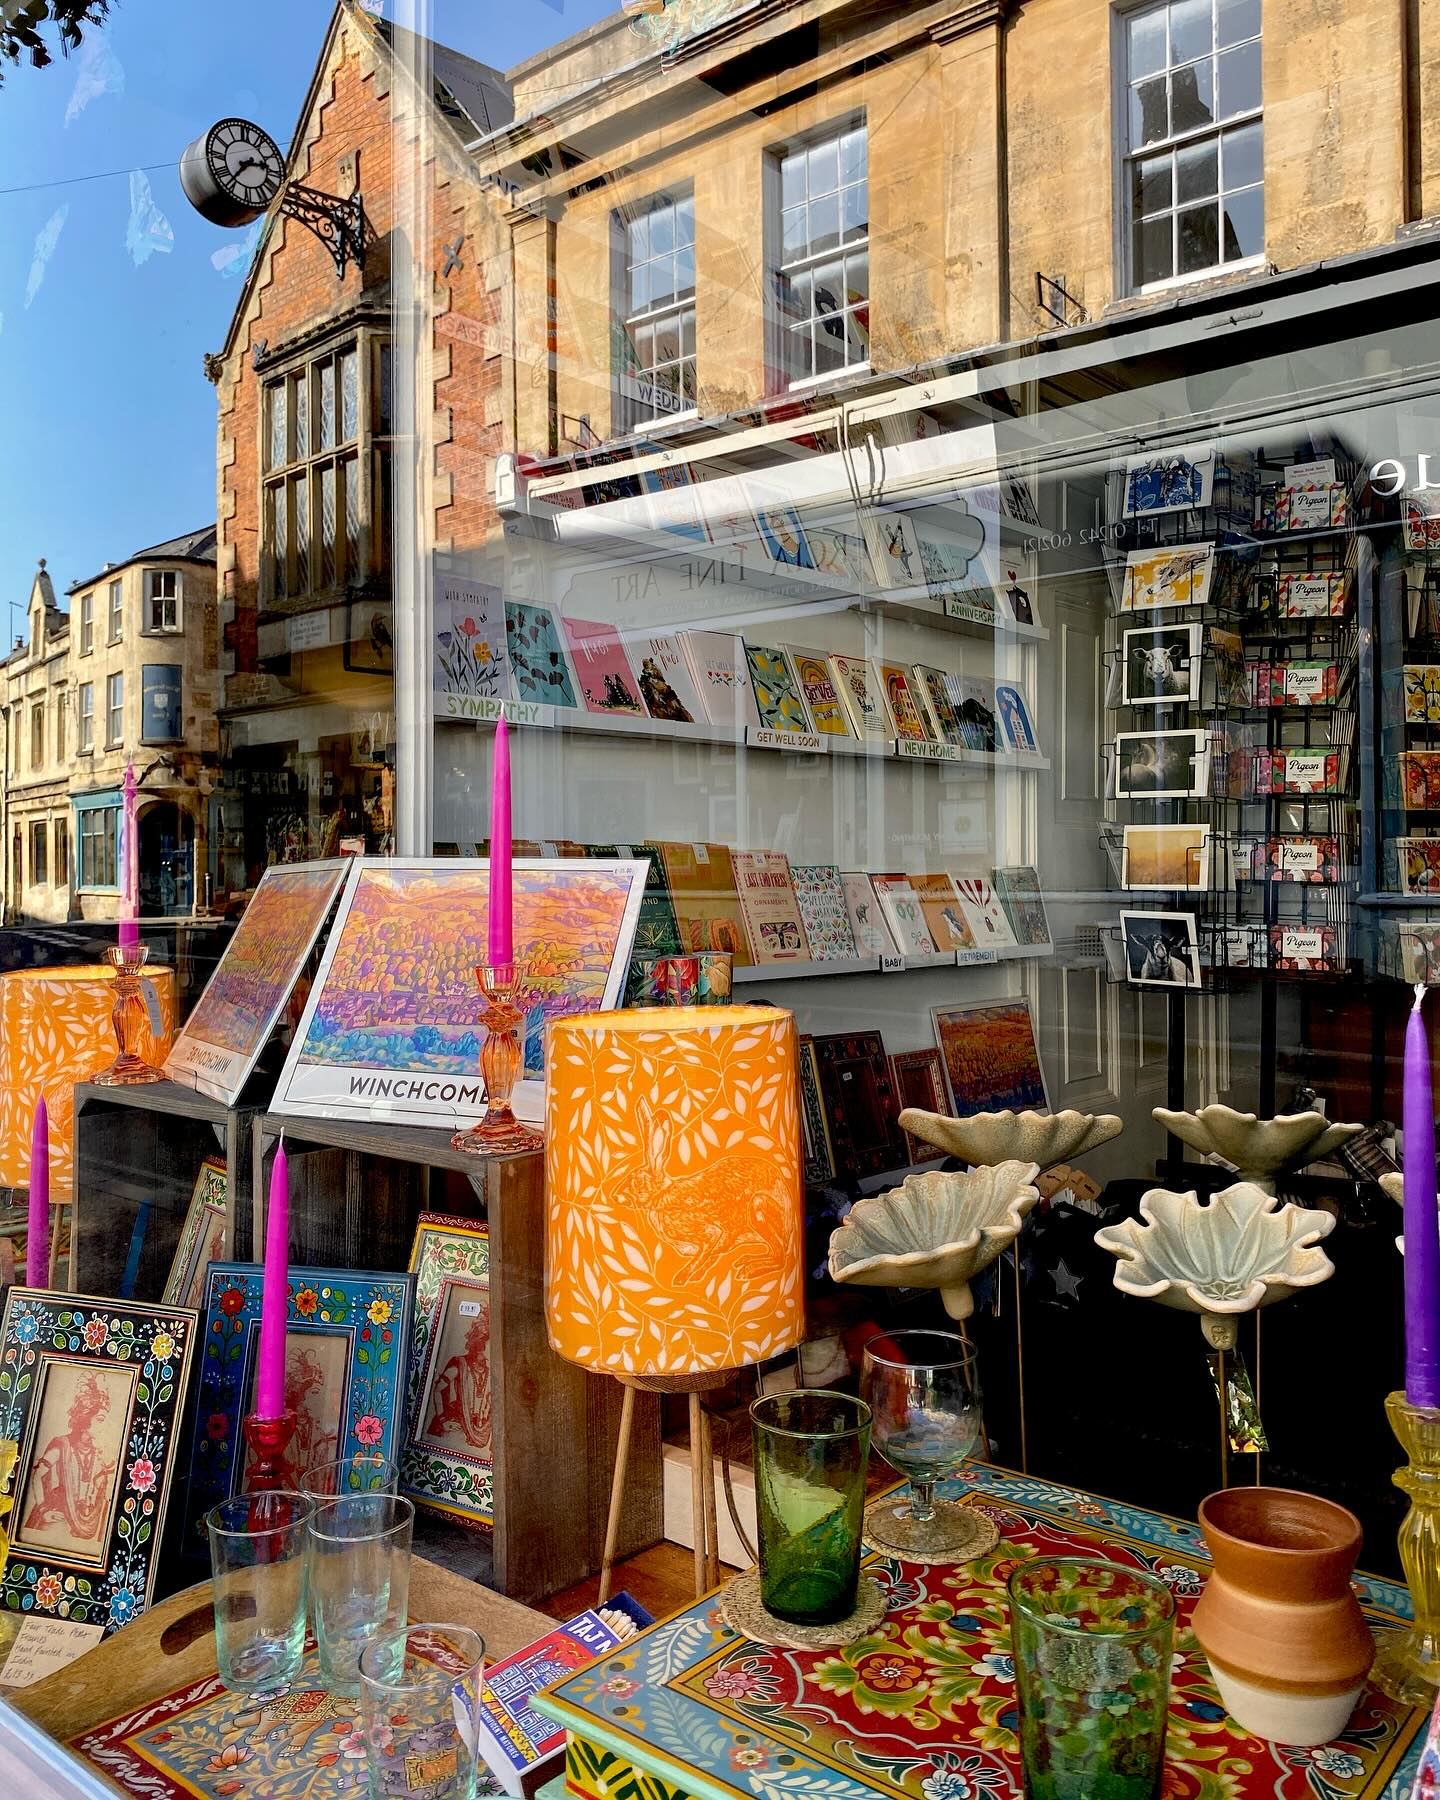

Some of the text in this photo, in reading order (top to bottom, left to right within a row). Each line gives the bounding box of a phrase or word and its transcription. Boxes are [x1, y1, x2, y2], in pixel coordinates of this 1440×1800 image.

[638, 383, 696, 412] WEDDIN
[1297, 494, 1327, 509] Pigeon
[1295, 583, 1327, 598] Pigeon
[951, 604, 1001, 625] ANNIVERSARY
[1287, 672, 1318, 684] Pigeon
[447, 695, 539, 723] SYMPATHY
[757, 731, 820, 748] GET WELL SOON
[904, 741, 956, 759] NEW HOME
[1289, 759, 1320, 772] Pigeon
[1283, 847, 1313, 861] Pigeon
[743, 872, 788, 889] EAST END PRESS
[808, 894, 839, 907] WELCOME
[1286, 935, 1317, 949] Pigeon
[884, 958, 902, 968] BABY
[960, 951, 995, 962] RETIREMENT
[566, 1616, 606, 1643] TAJ
[480, 1704, 520, 1760] MAGNIFICENT MATCHES
